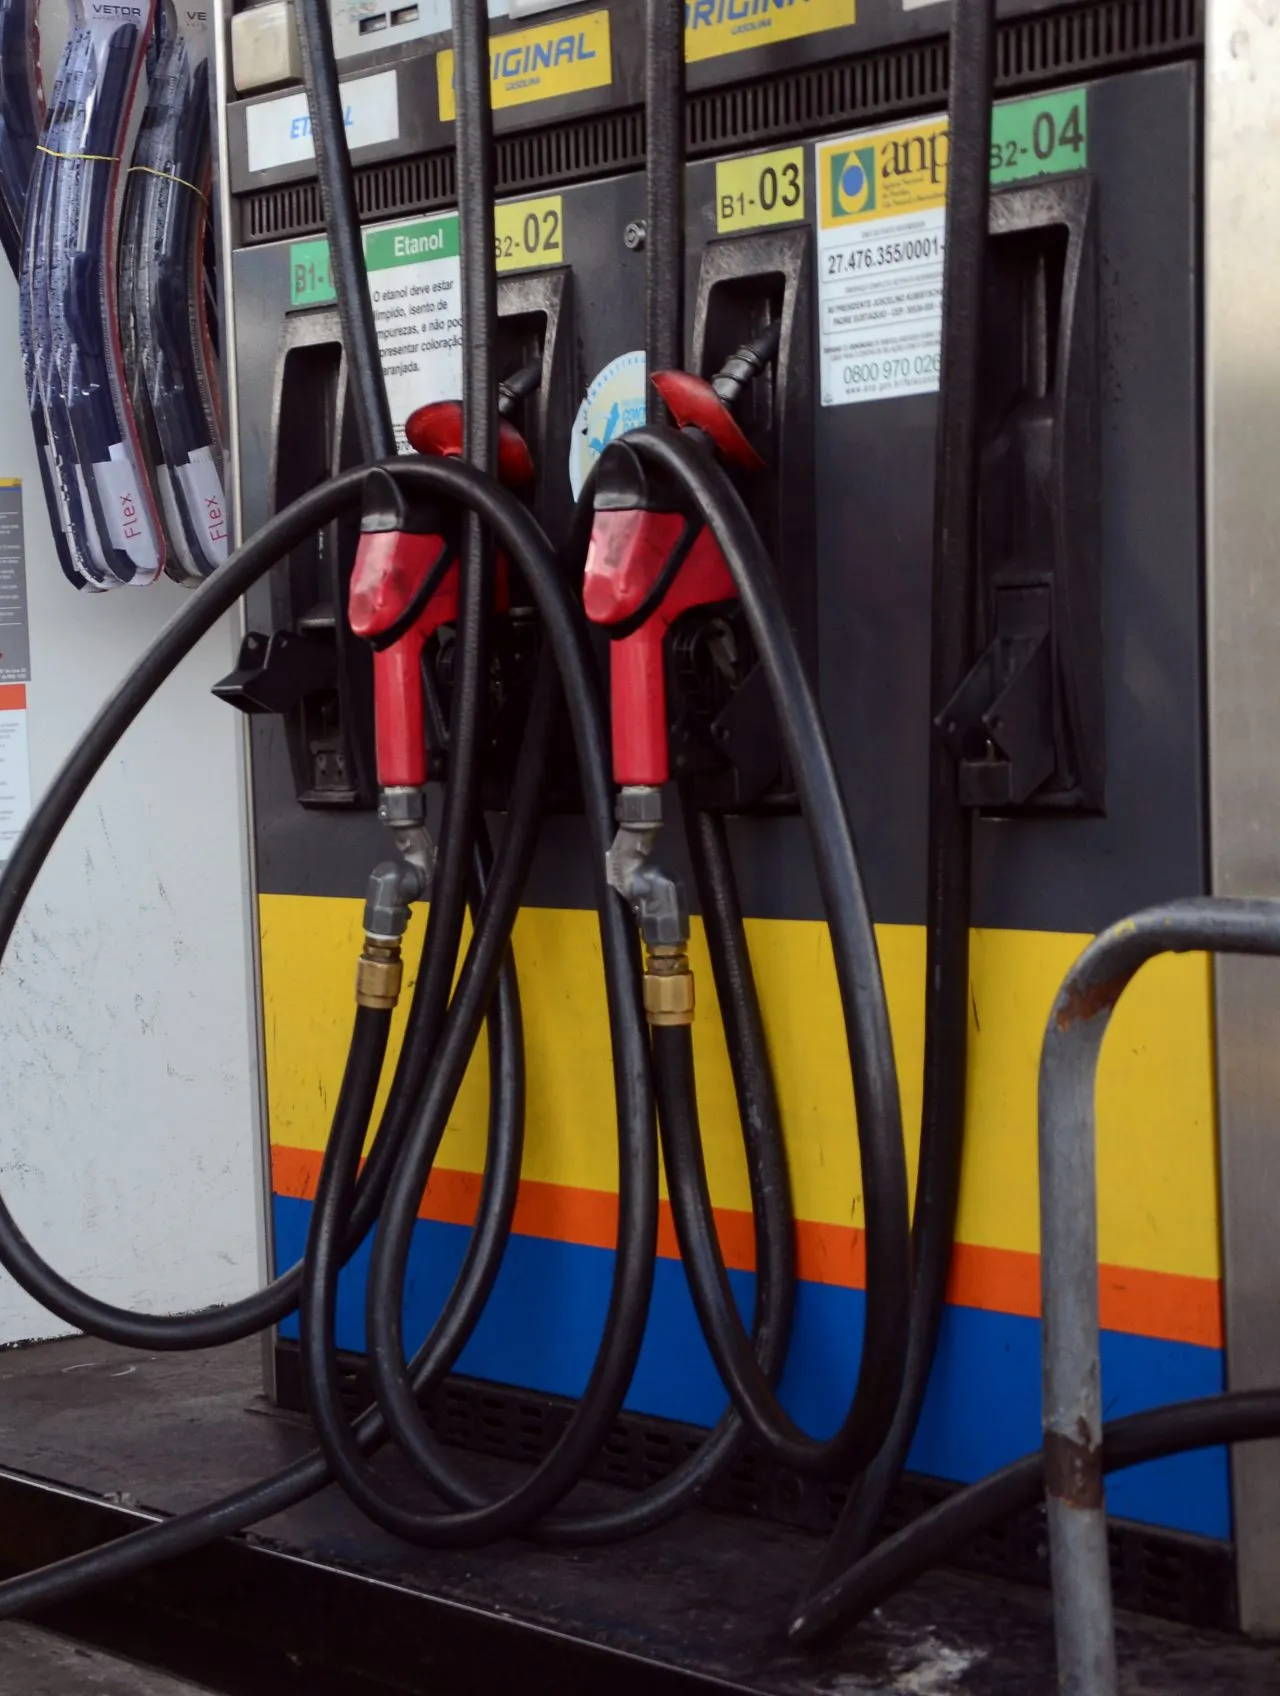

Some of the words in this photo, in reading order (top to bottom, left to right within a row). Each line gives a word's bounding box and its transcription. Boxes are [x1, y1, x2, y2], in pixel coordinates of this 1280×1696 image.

[92, 4, 141, 17] VETOR
[452, 32, 596, 90] IGINAL
[290, 105, 353, 139] ETL
[990, 105, 1084, 170] B2-04
[881, 130, 949, 184] anp
[721, 162, 800, 219] B1-03
[394, 228, 444, 257] Etanol
[828, 236, 944, 274] 27.476.355/0001-
[373, 291, 380, 302] O
[383, 286, 407, 301] etanol
[409, 284, 430, 296] deve
[432, 280, 454, 292] estar
[409, 302, 435, 315] isento
[437, 299, 448, 310] de
[377, 325, 419, 340] mpurezas,
[421, 323, 426, 332] e
[429, 318, 445, 331] não
[379, 344, 419, 357] presentar
[382, 360, 420, 376] aranjada.
[843, 362, 879, 384] 0800
[883, 358, 910, 379] 970
[914, 353, 941, 374] 026
